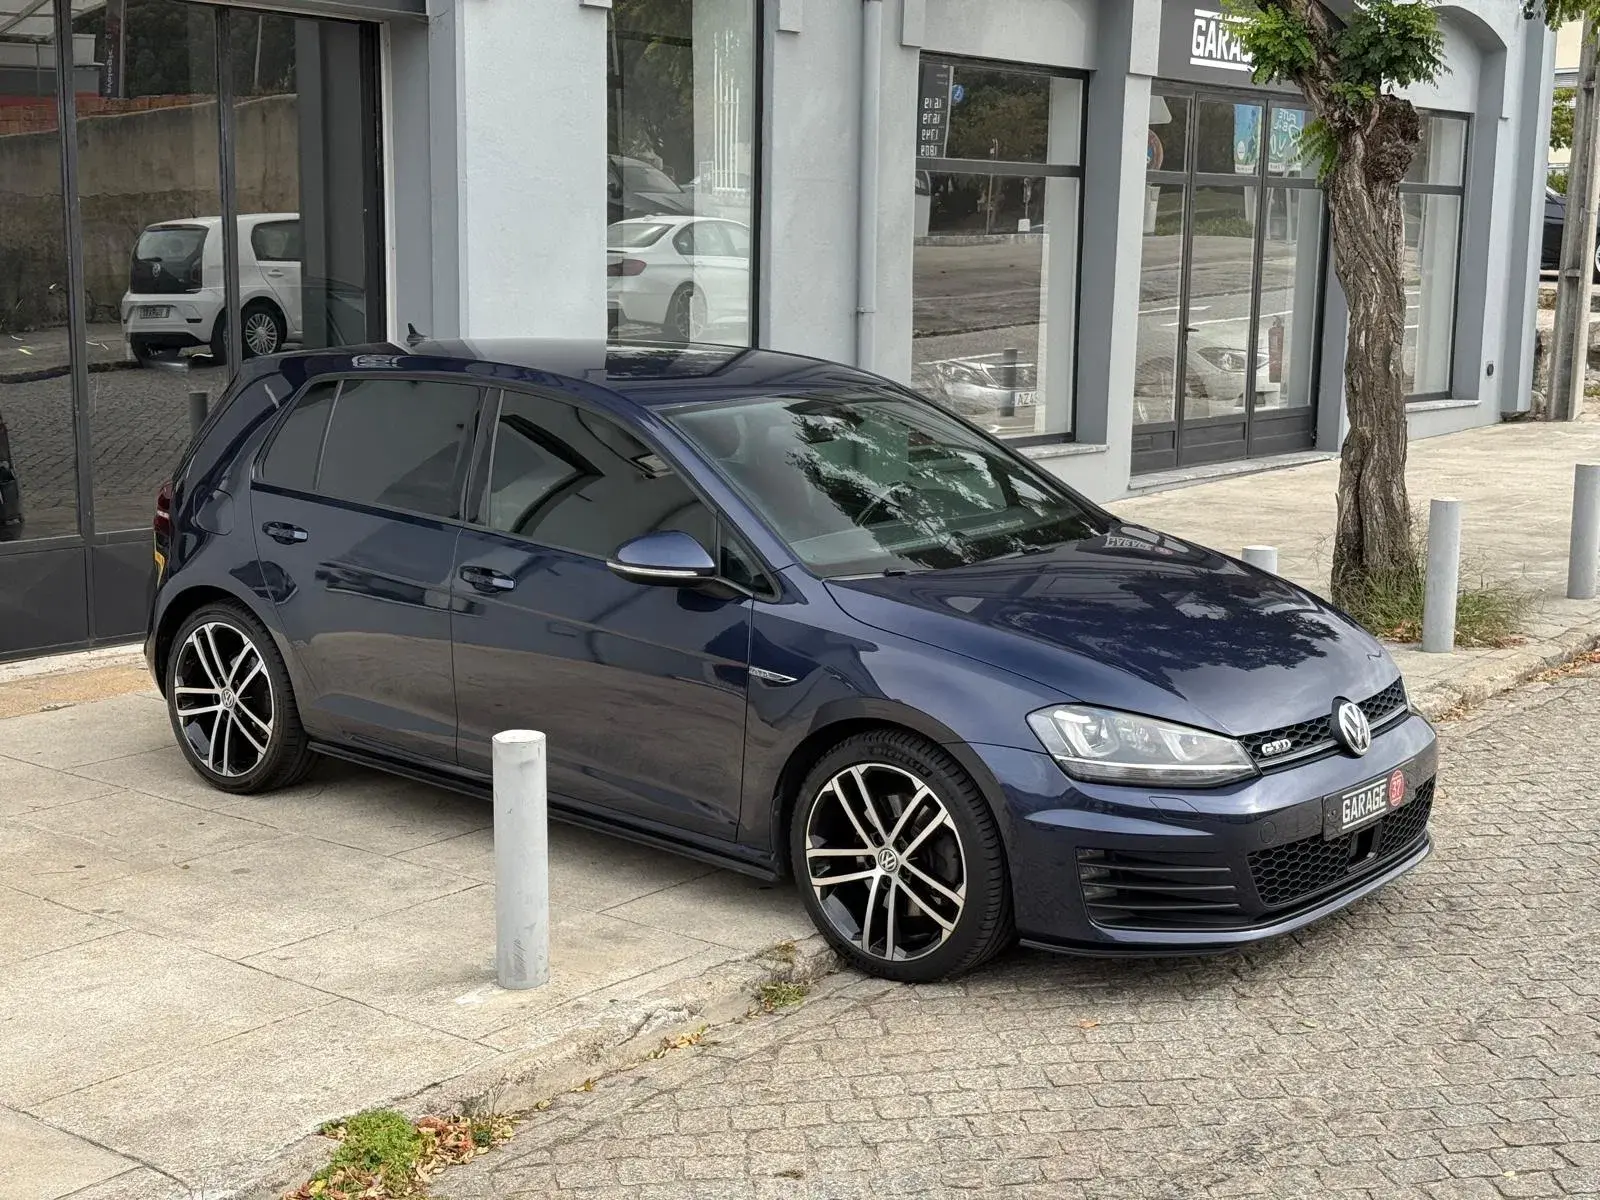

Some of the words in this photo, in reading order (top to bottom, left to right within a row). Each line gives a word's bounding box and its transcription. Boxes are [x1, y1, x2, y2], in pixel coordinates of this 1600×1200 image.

[1261, 739, 1292, 757] GTD
[1342, 784, 1386, 823] GARAGE
[1391, 778, 1402, 799] 37
